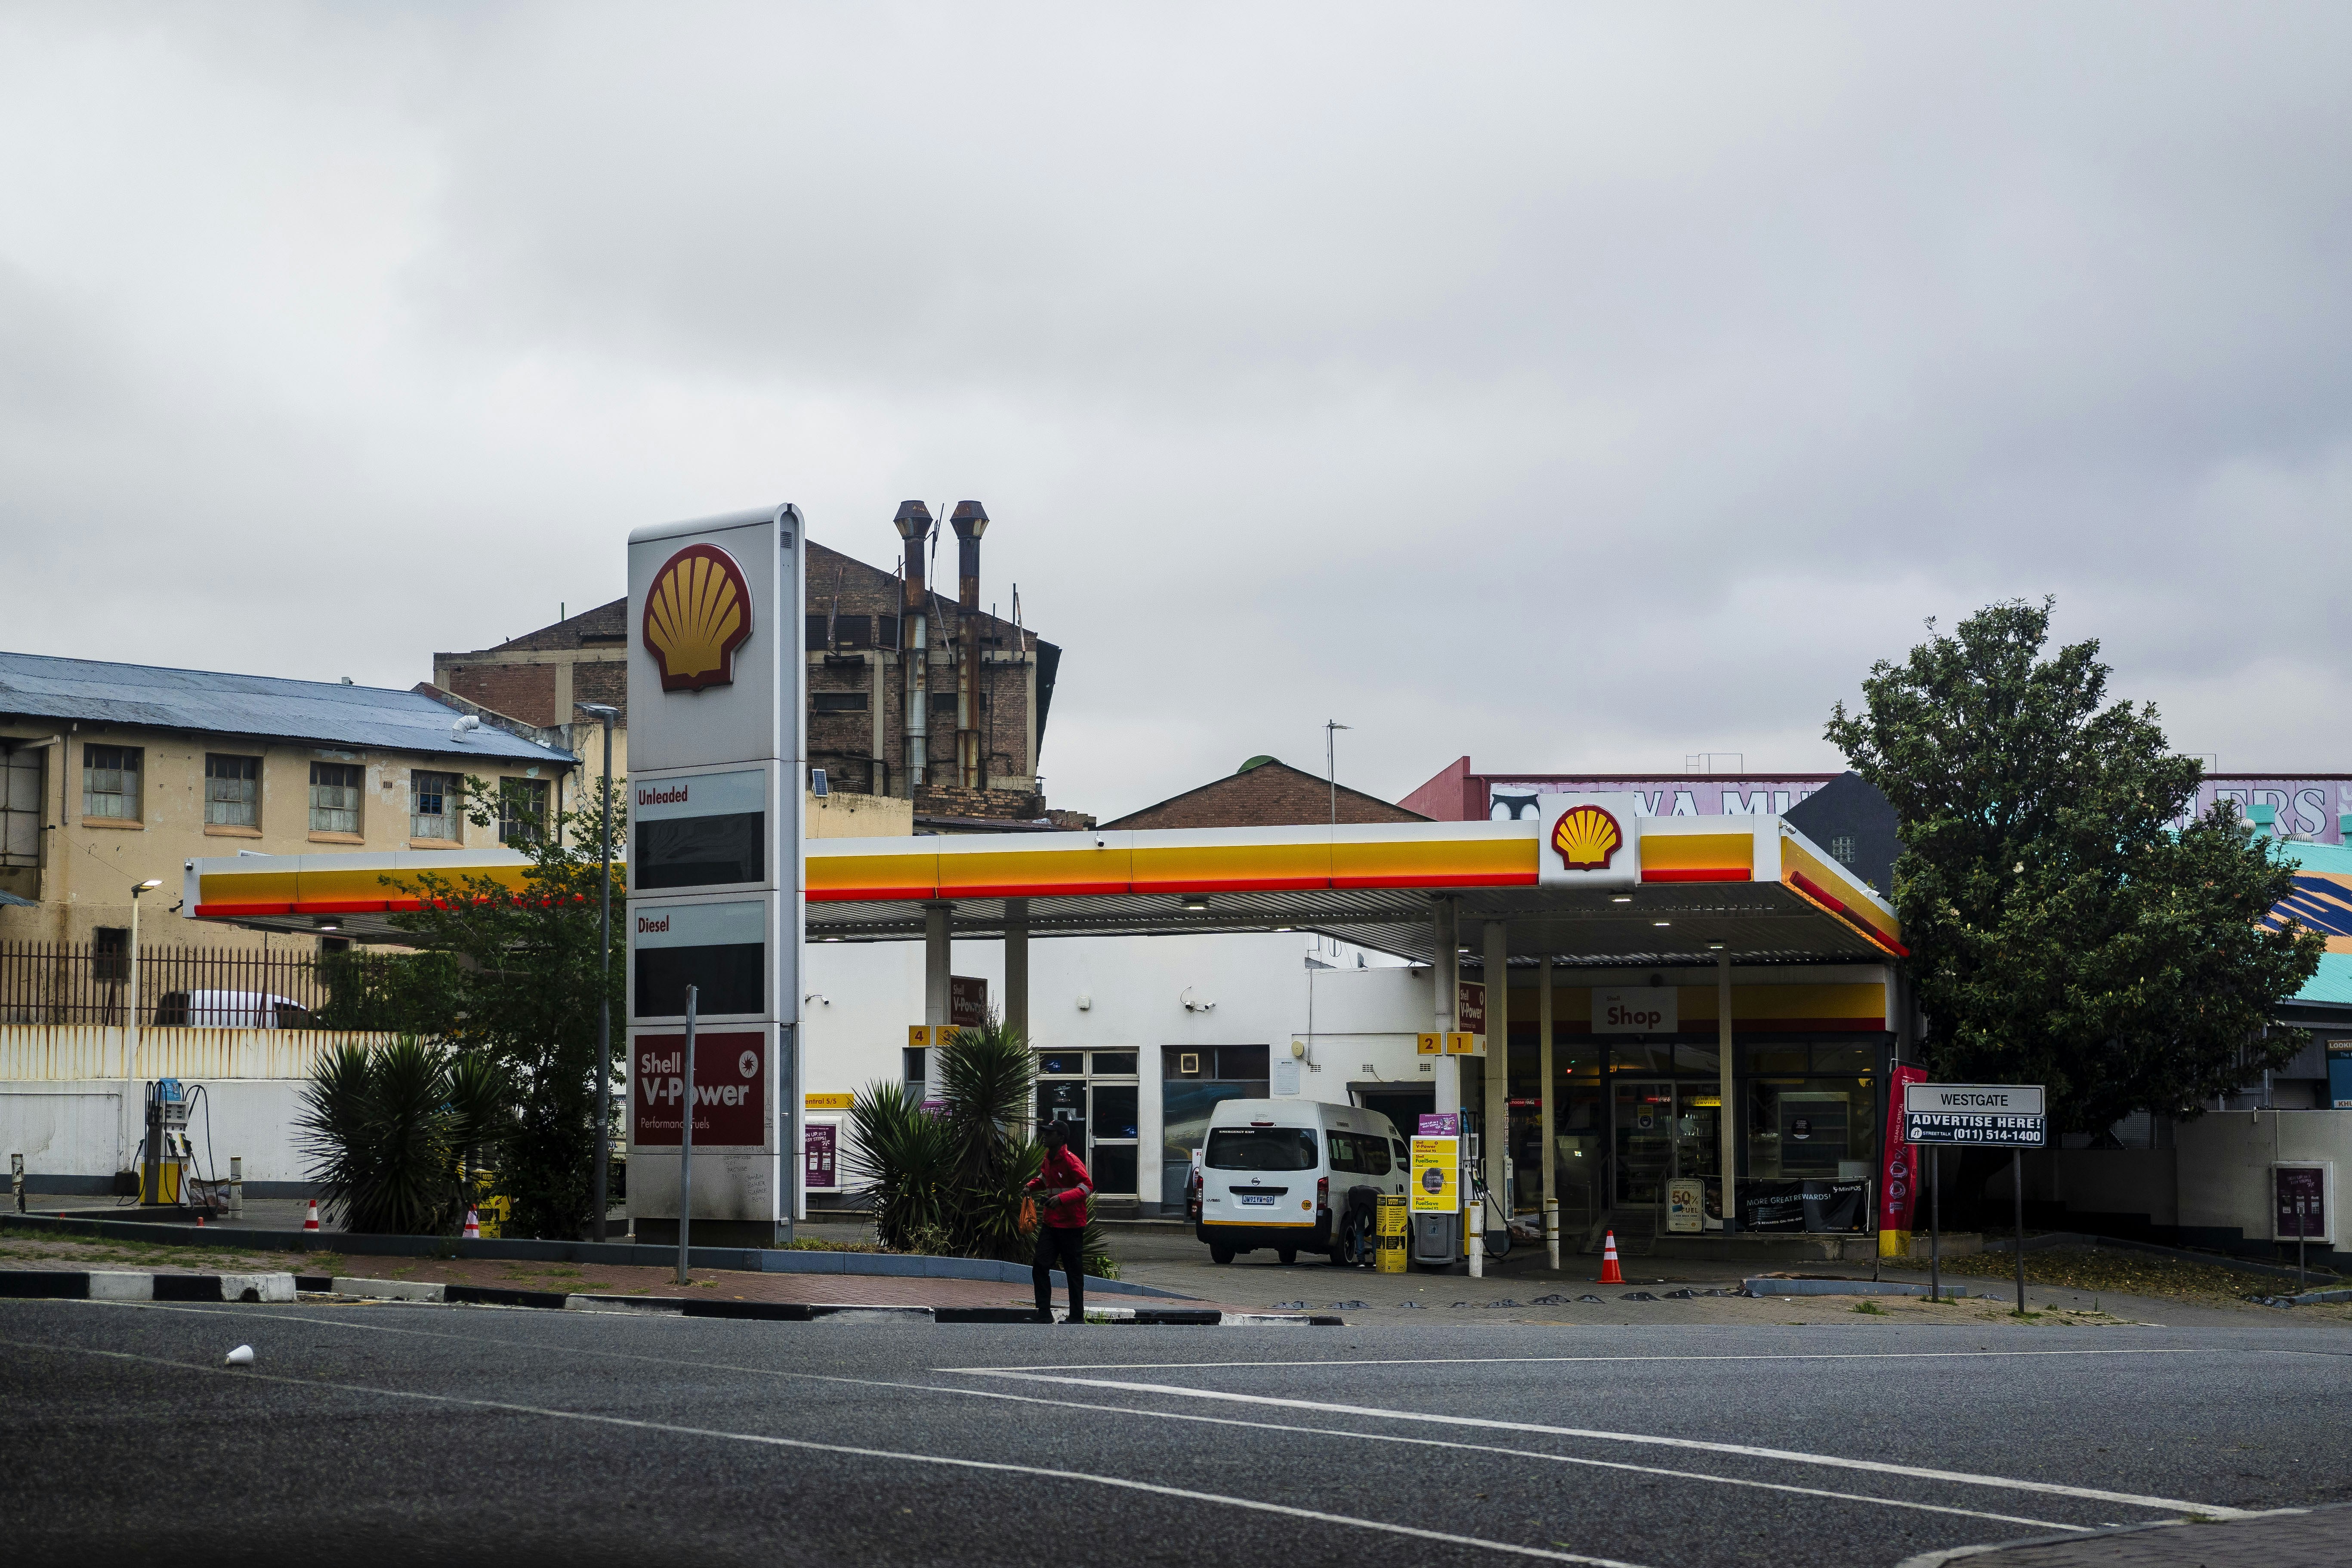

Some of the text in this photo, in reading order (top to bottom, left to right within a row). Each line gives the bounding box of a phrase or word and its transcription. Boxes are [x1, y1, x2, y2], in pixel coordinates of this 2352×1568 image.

[639, 785, 688, 805] Unleaded
[638, 915, 669, 933] Diesel
[953, 984, 964, 995] Shell
[1460, 989, 1469, 1000] Shell
[1460, 1002, 1482, 1019] V-Power
[1607, 1005, 1661, 1030] Shop
[914, 1031, 924, 1042] 4
[1425, 1037, 1433, 1049] 2
[1457, 1037, 1462, 1049] 1
[641, 1052, 681, 1073] Shell
[1941, 1093, 2009, 1106] WESTGATE
[641, 1116, 684, 1128] Performanc
[1912, 1114, 2041, 1129] ADVERTISE HERE!
[1954, 1128, 2040, 1142] (011) 514-1400
[1889, 1146, 1908, 1214] 100%
[1672, 1191, 1698, 1205] 50%
[1747, 1193, 1831, 1206] MORE GREAT REWARDS!
